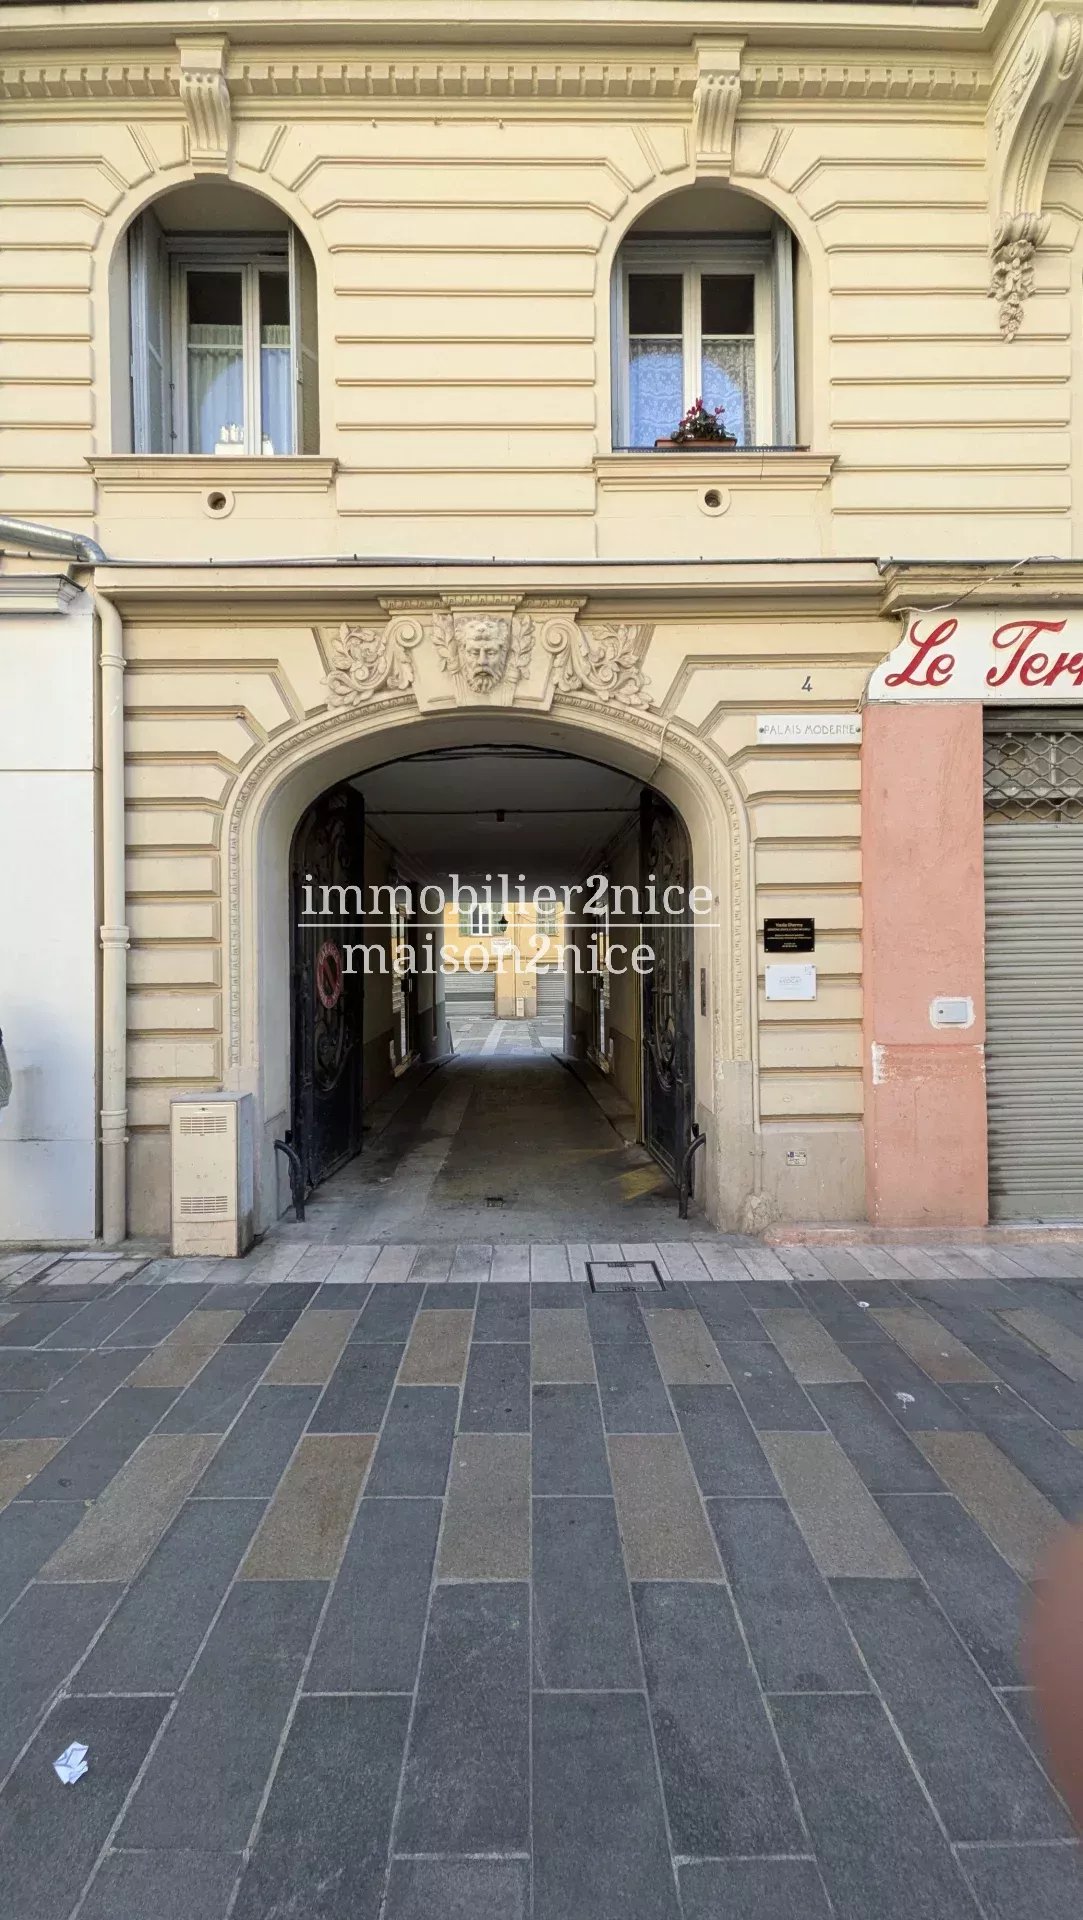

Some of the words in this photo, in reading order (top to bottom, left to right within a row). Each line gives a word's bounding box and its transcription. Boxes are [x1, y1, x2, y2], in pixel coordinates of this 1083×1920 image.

[884, 618, 958, 687] Le
[801, 675, 813, 692] 4
[763, 724, 801, 735] PALAIS
[804, 724, 857, 735] MODERNE
